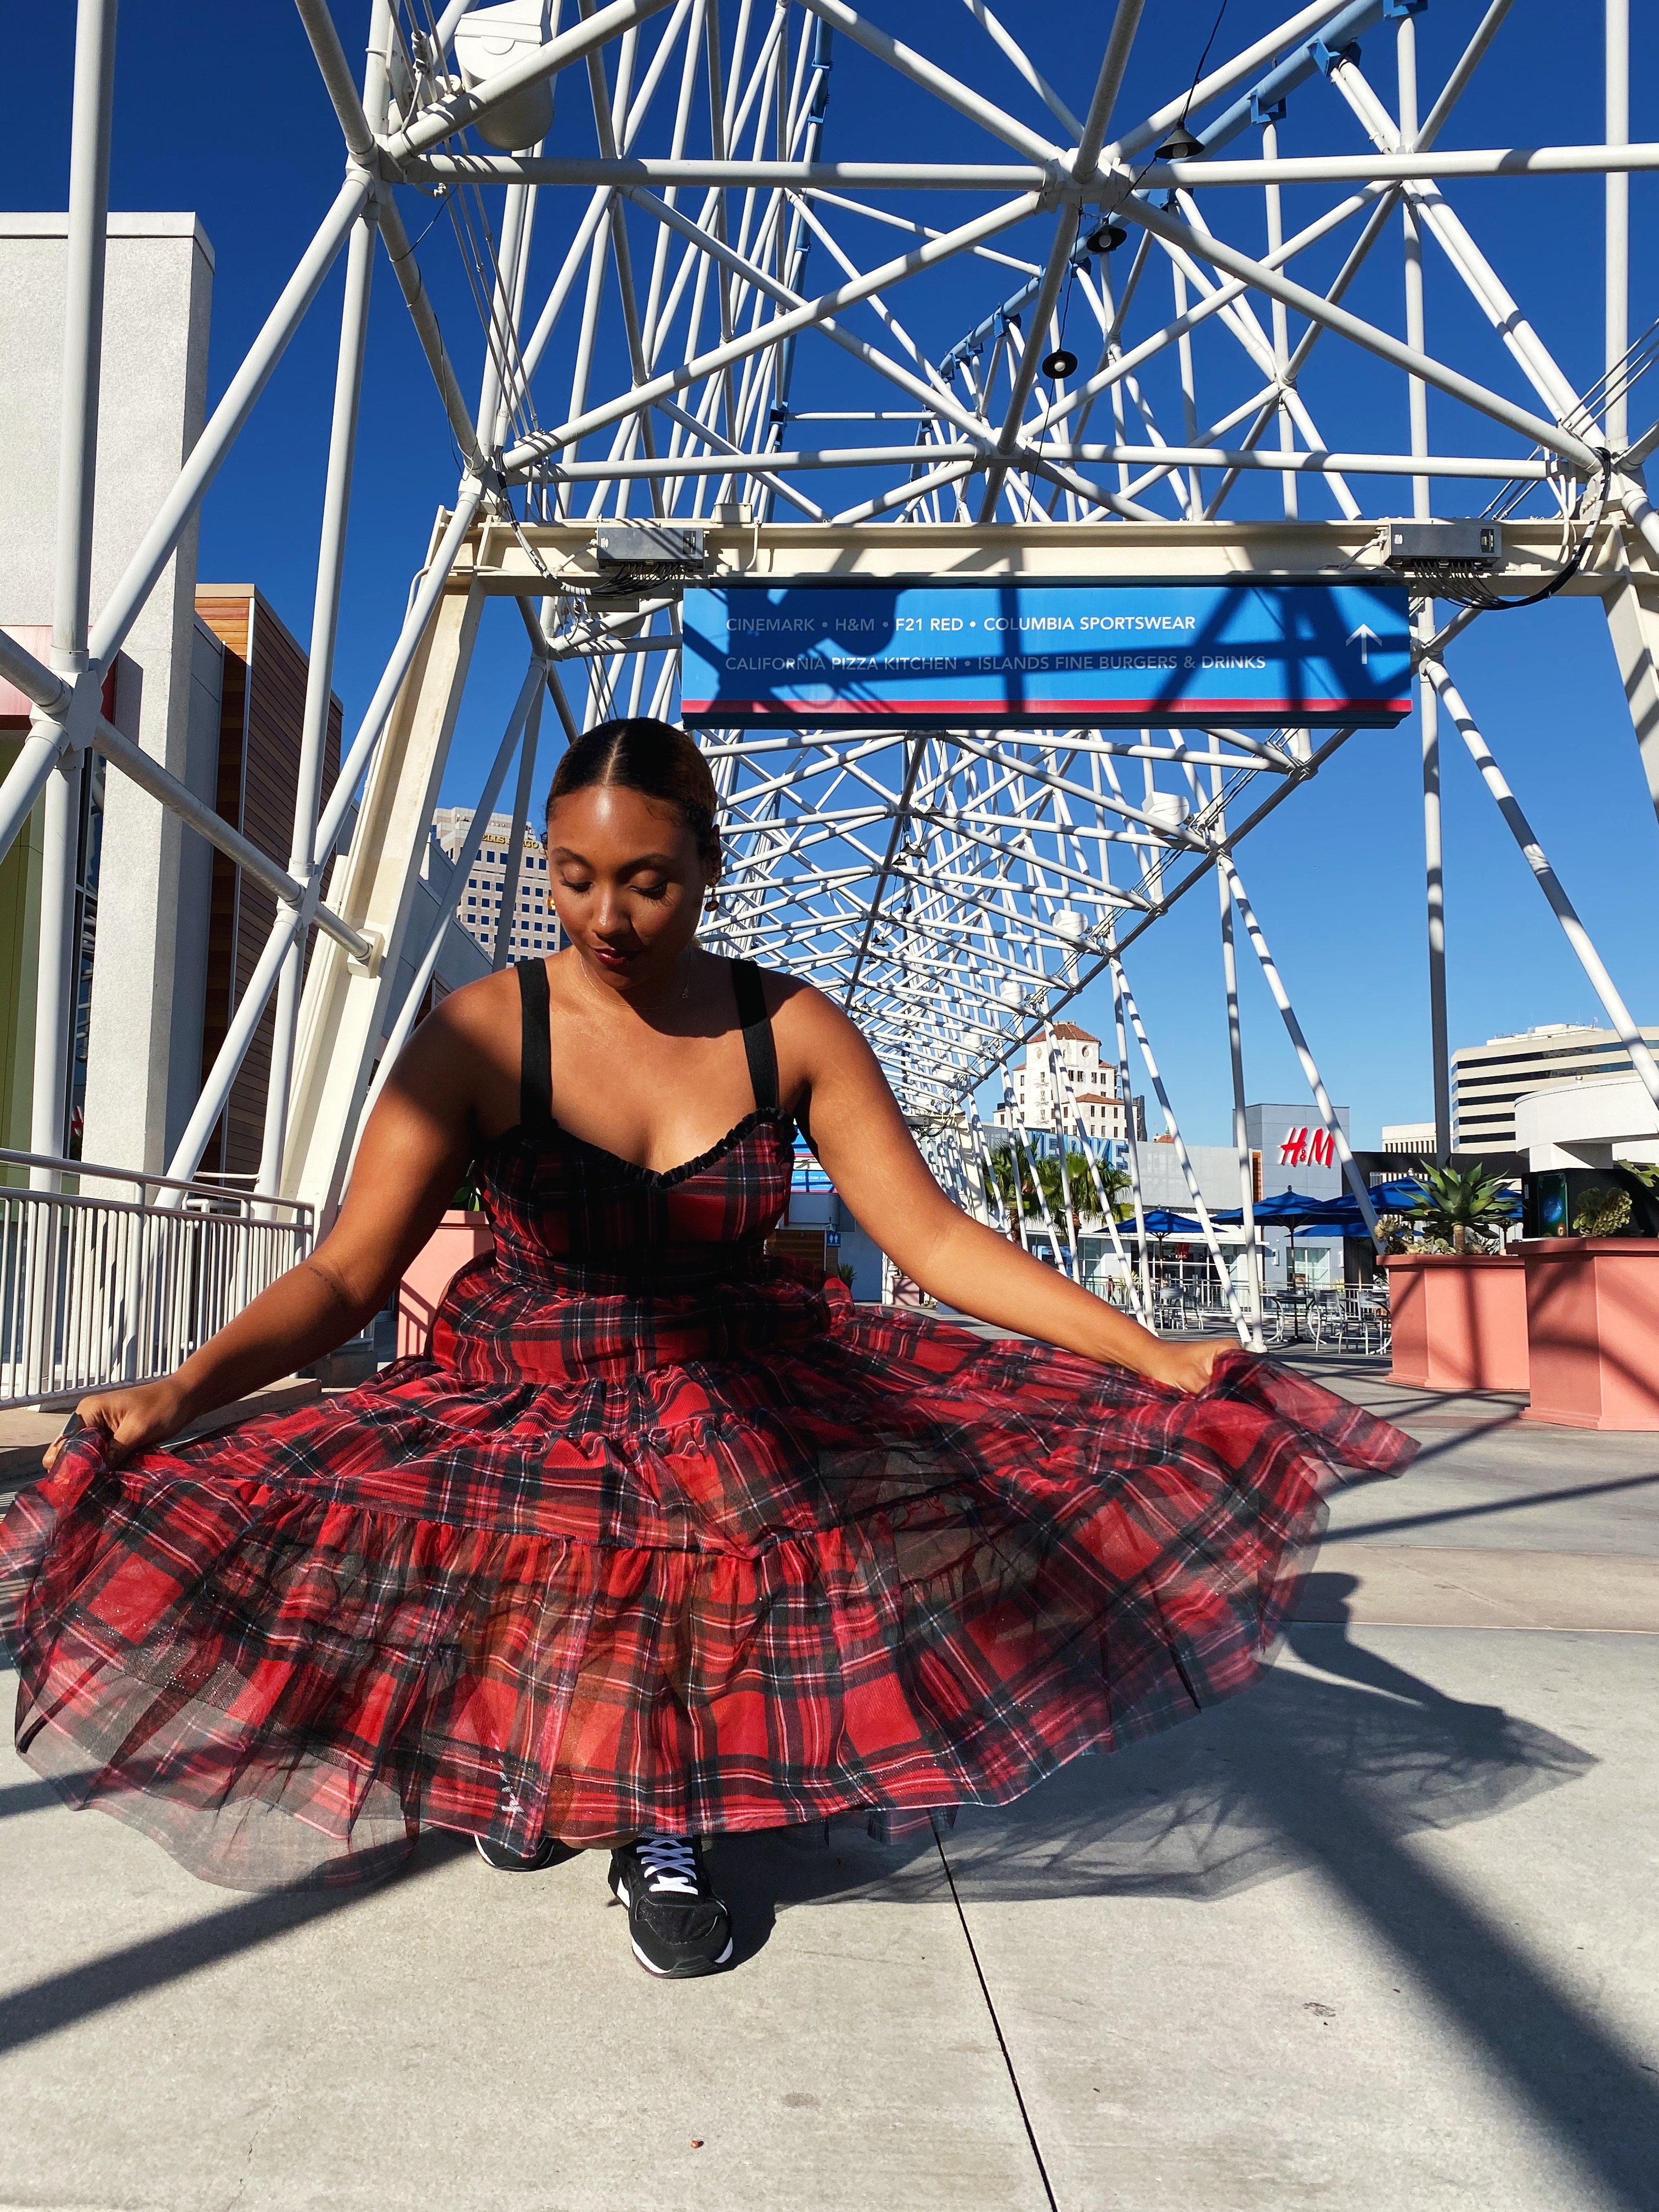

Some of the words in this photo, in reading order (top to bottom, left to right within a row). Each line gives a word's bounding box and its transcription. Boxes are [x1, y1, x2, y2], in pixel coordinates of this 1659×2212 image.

[726, 618, 815, 631] CINEMARK
[835, 618, 874, 631] H&M
[896, 618, 922, 631] F21
[930, 618, 963, 631] RED
[984, 617, 1075, 631] COLUMBIA
[1080, 616, 1195, 630] SPORTSWEAR
[725, 657, 825, 670] CALIFORNIA
[832, 657, 878, 670] PIZZA
[884, 657, 957, 670] KITCHEN
[978, 657, 1049, 670] ISLANDS
[1056, 656, 1093, 669] FINE
[1099, 656, 1177, 669] BURGERS
[1183, 656, 1196, 669] &
[1201, 656, 1266, 669] DRINKS
[1279, 1127, 1335, 1169] H&M
